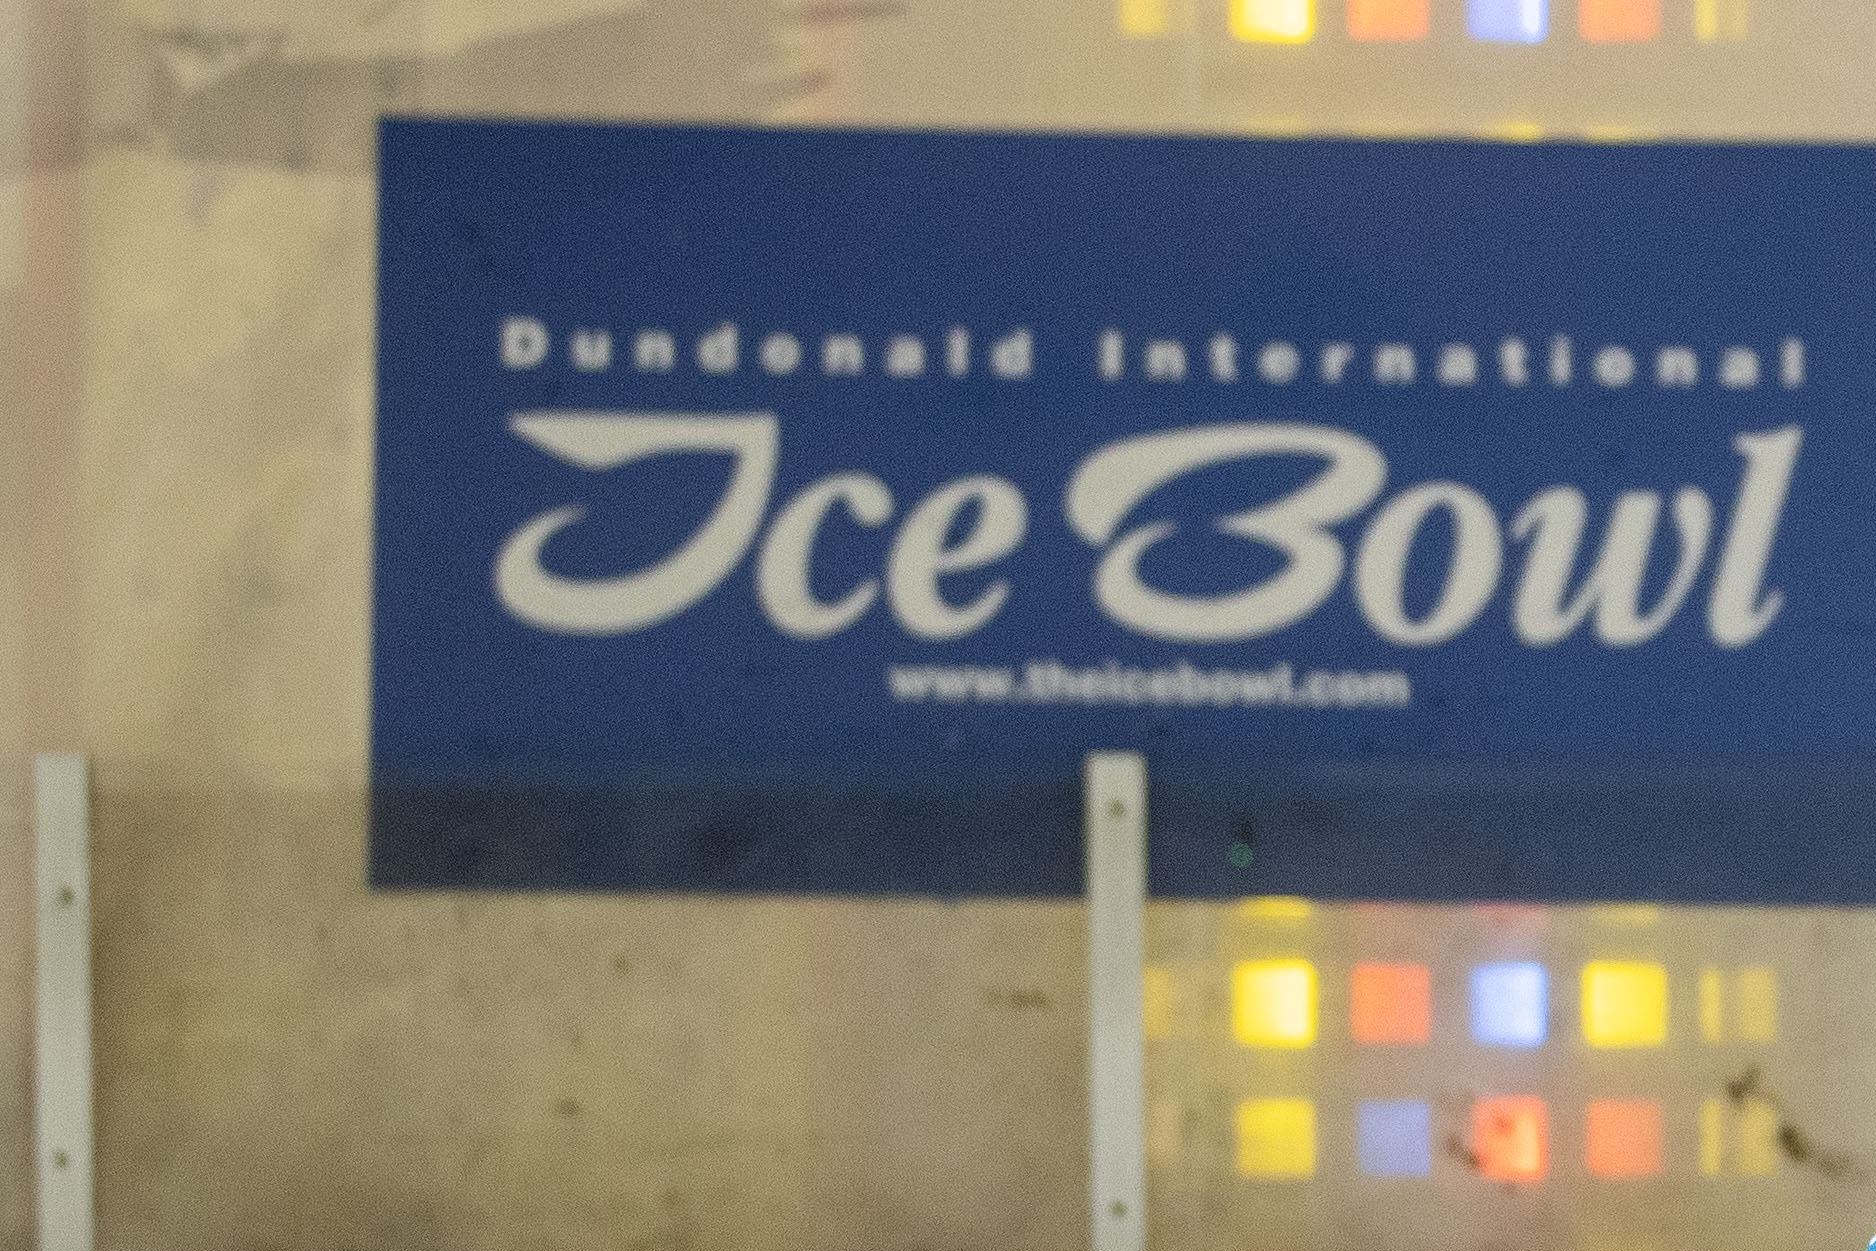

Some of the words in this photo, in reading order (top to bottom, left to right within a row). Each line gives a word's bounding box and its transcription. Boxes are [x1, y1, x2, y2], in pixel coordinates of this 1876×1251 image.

[501, 317, 1033, 380] Dundonald
[1100, 330, 1804, 388] International
[494, 411, 1027, 639] Ice
[1064, 421, 1803, 647] Bowl
[887, 660, 1411, 706] www.theicebowl.com
